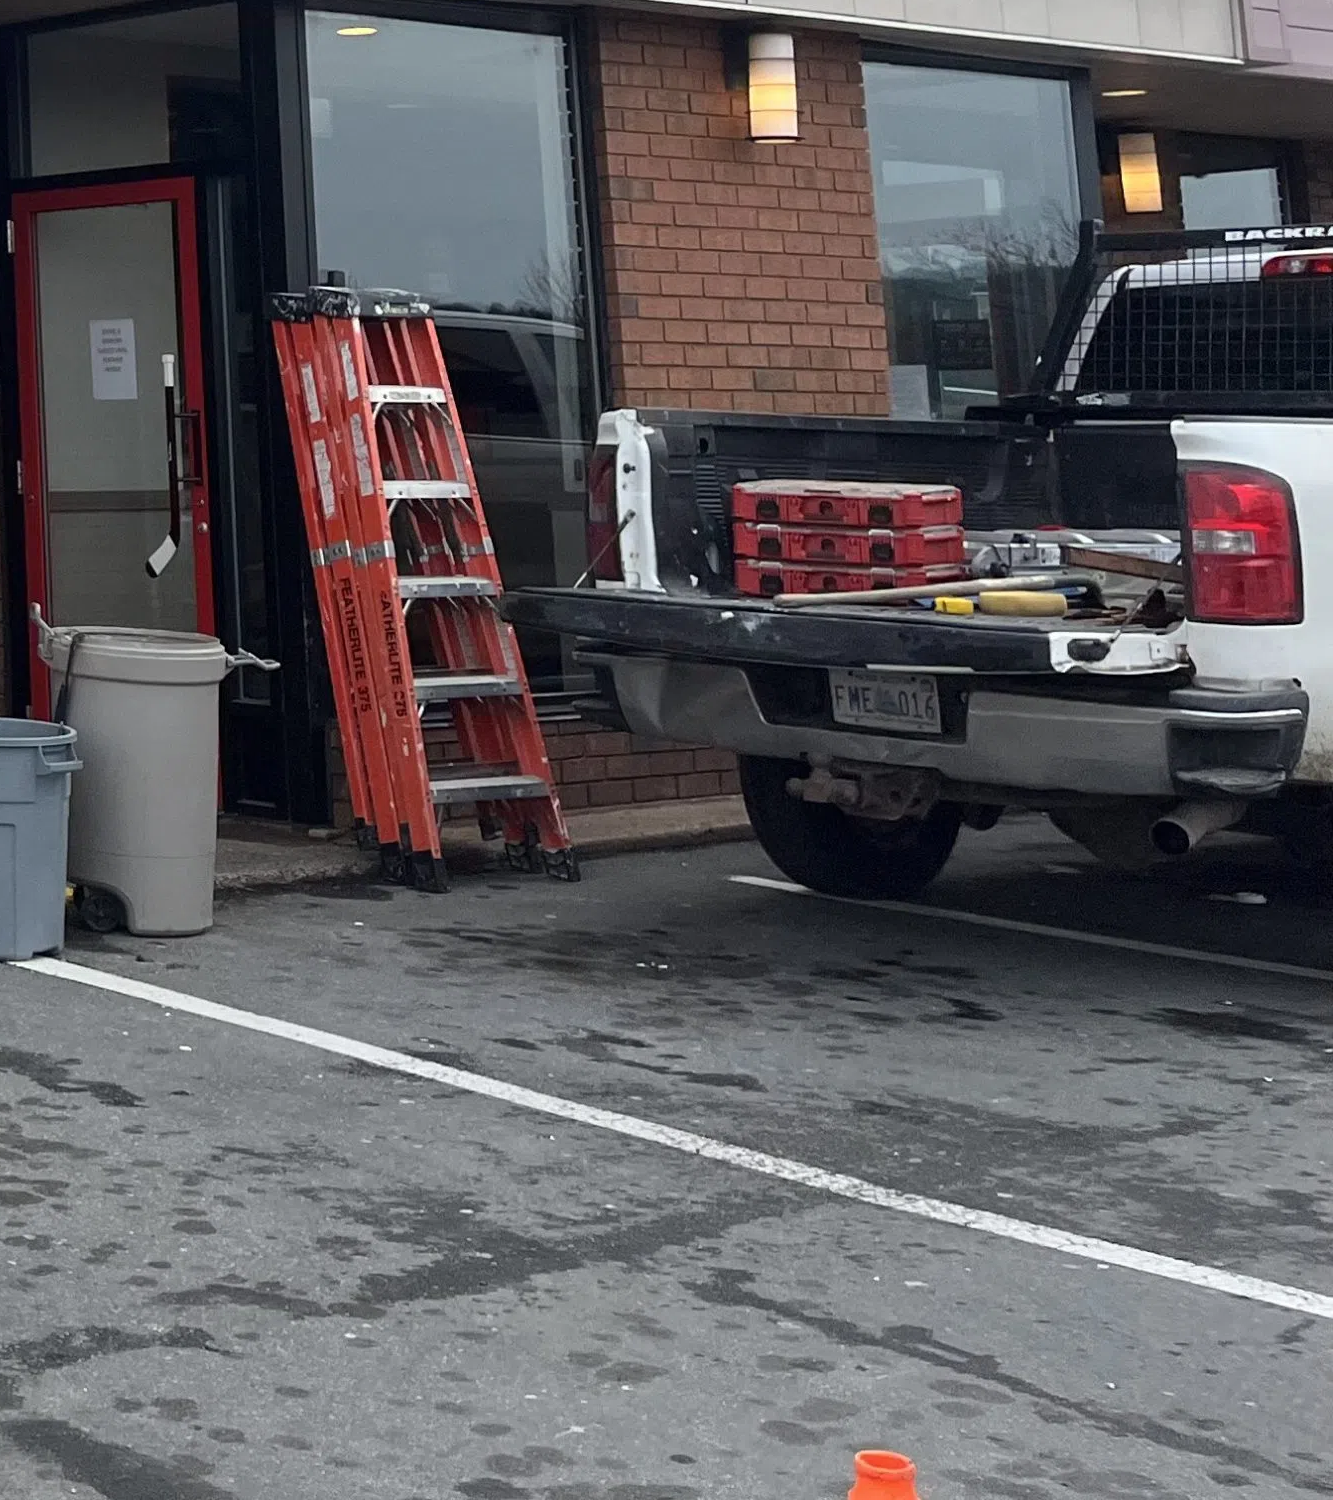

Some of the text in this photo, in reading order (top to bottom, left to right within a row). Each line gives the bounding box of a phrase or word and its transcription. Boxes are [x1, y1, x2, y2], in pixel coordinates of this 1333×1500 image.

[1224, 226, 1333, 242] BACKR
[339, 577, 367, 681] FEATHERLITE
[357, 686, 372, 713] 375
